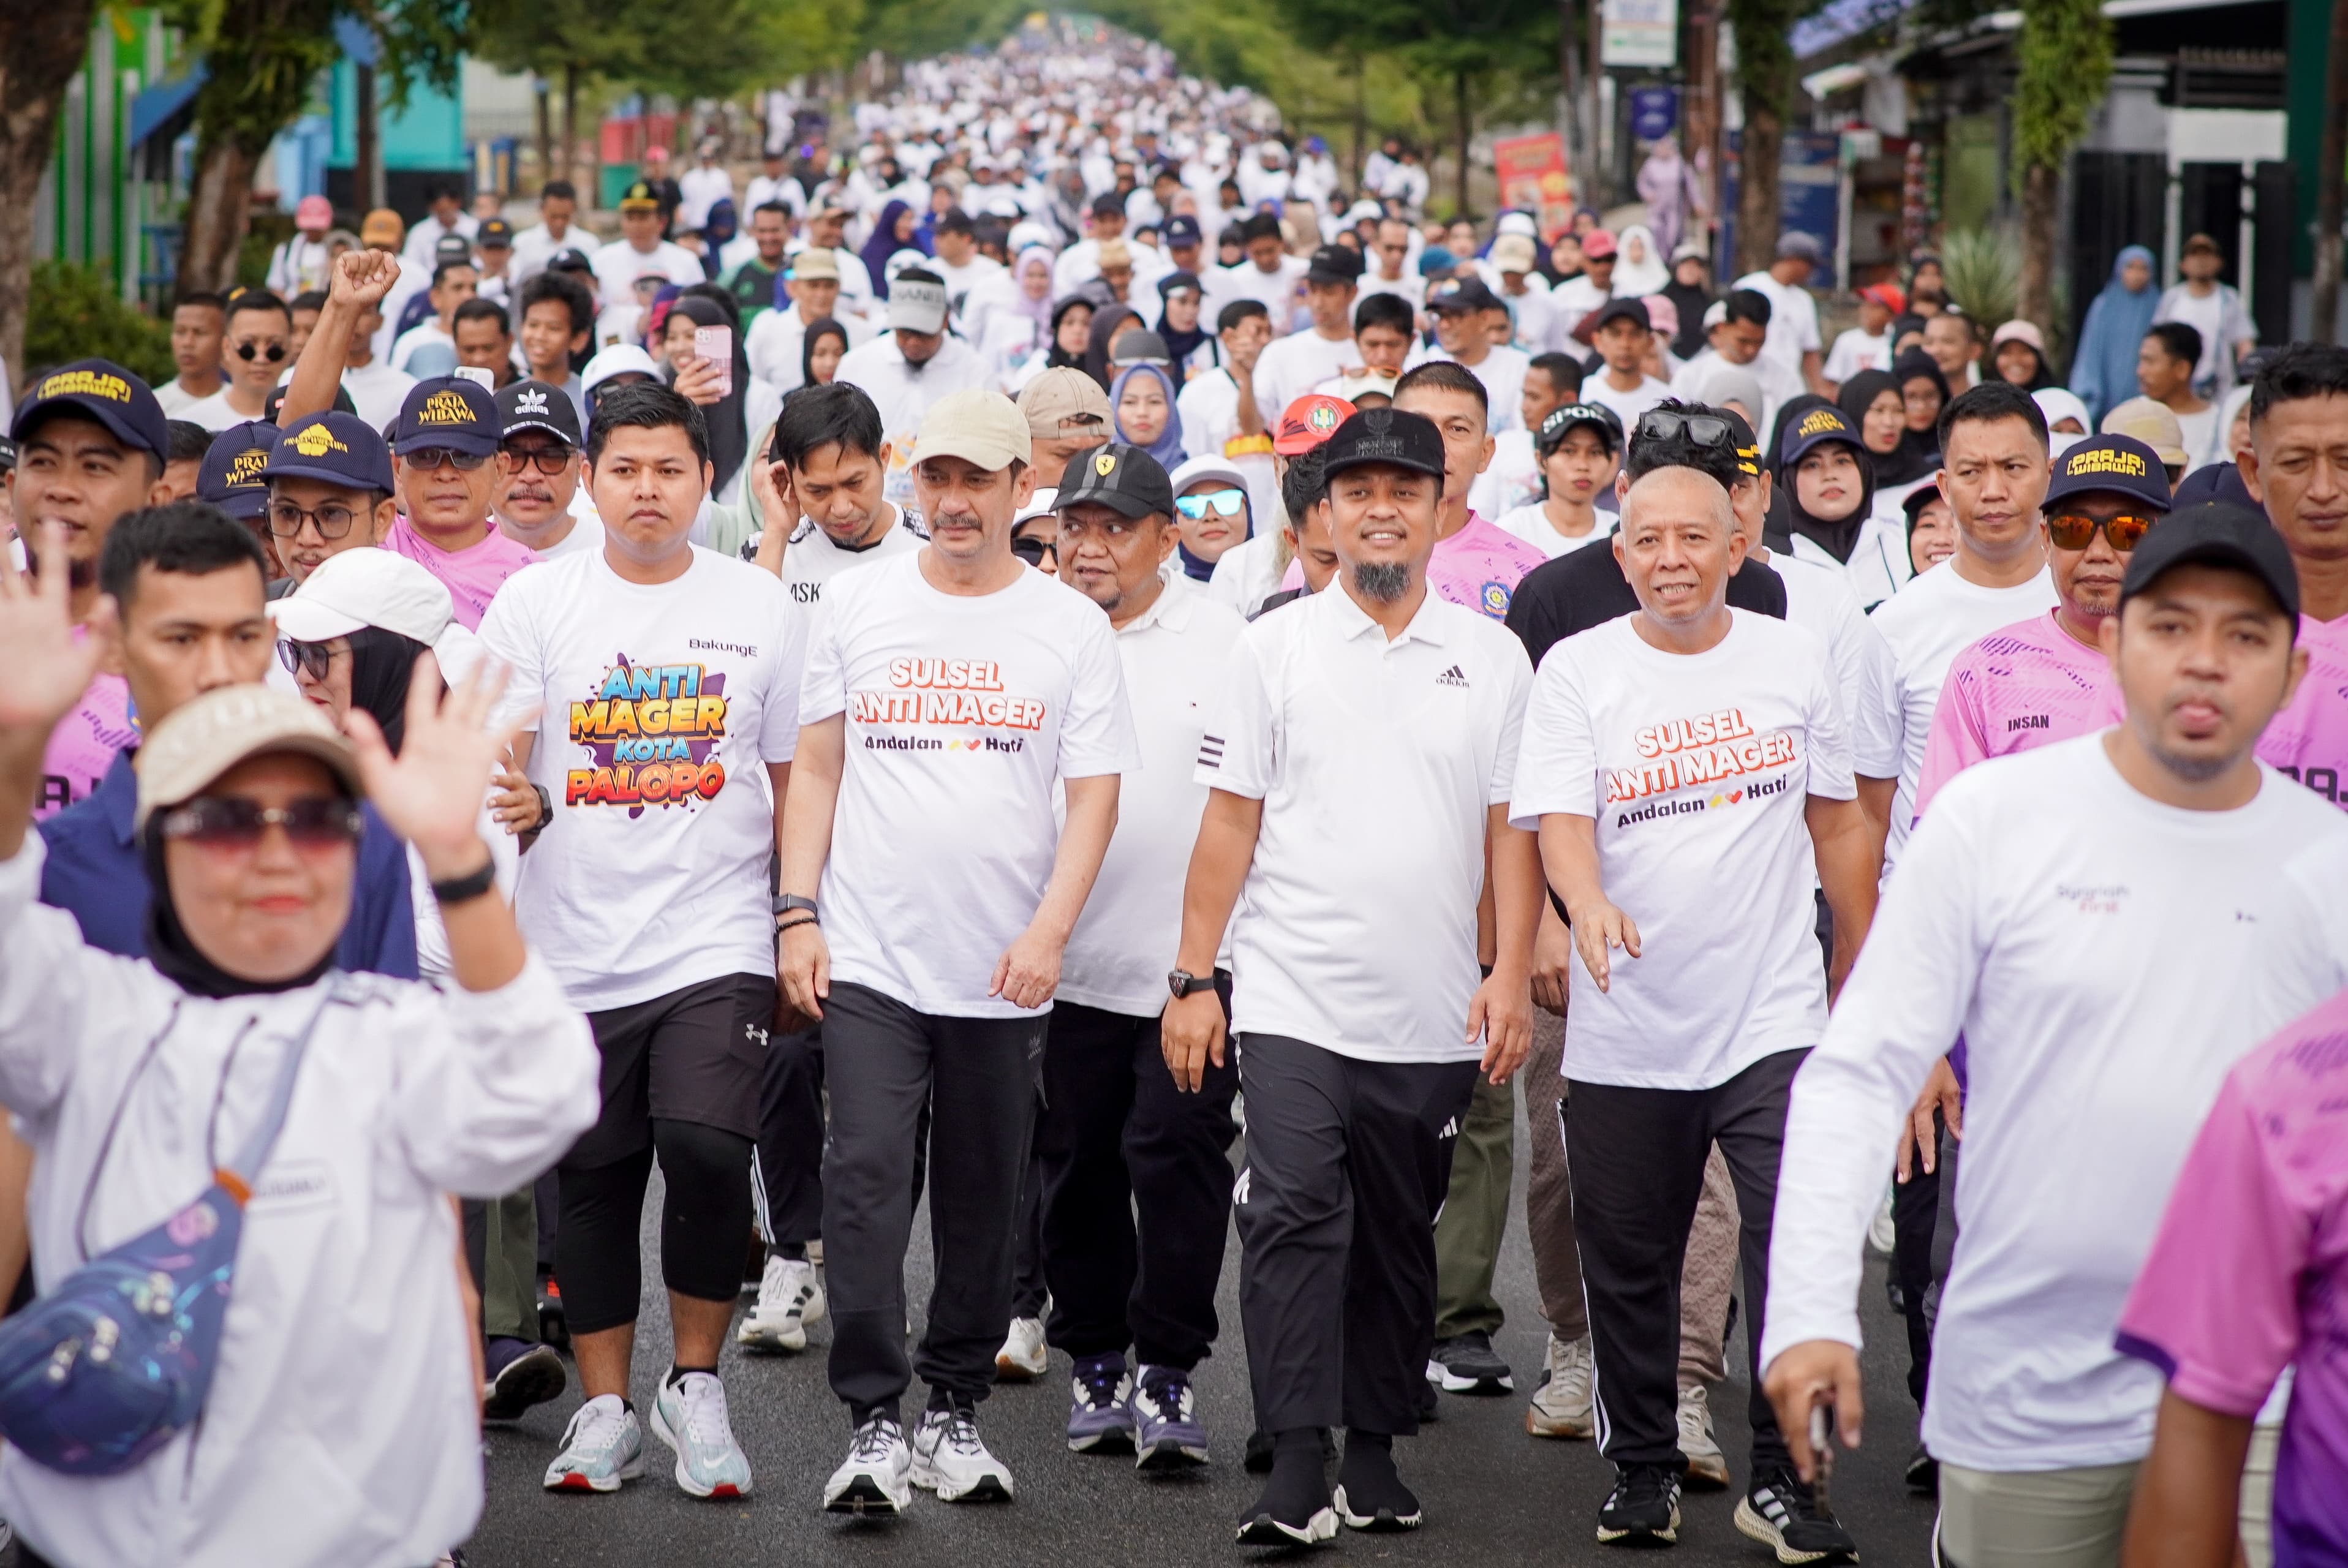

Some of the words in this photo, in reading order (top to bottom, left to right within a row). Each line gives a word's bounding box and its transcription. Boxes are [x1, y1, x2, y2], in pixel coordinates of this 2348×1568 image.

[426, 395, 469, 410] PRAJA
[515, 404, 549, 415] adidas
[234, 455, 268, 471] PRAJ
[2072, 449, 2140, 469] PRAJA
[2074, 461, 2136, 476] WIBAWA
[598, 665, 705, 701] ANTI
[889, 658, 1003, 691] SULSEL
[1436, 676, 1470, 687] adidas
[570, 698, 727, 739] MAGER
[853, 693, 921, 723] ANTI
[926, 693, 1045, 730] MAGER
[2008, 714, 2048, 733] INSAN
[865, 736, 942, 751] Andalan
[986, 737, 1024, 753] Hati
[1636, 708, 1753, 758] SULSEL
[614, 738, 692, 764] KOTA
[1603, 758, 1679, 803] ANTI
[1685, 730, 1795, 785] MAGER
[566, 763, 726, 805] PALOPO
[1618, 797, 1705, 828] Andalan
[1747, 774, 1787, 799] Hati
